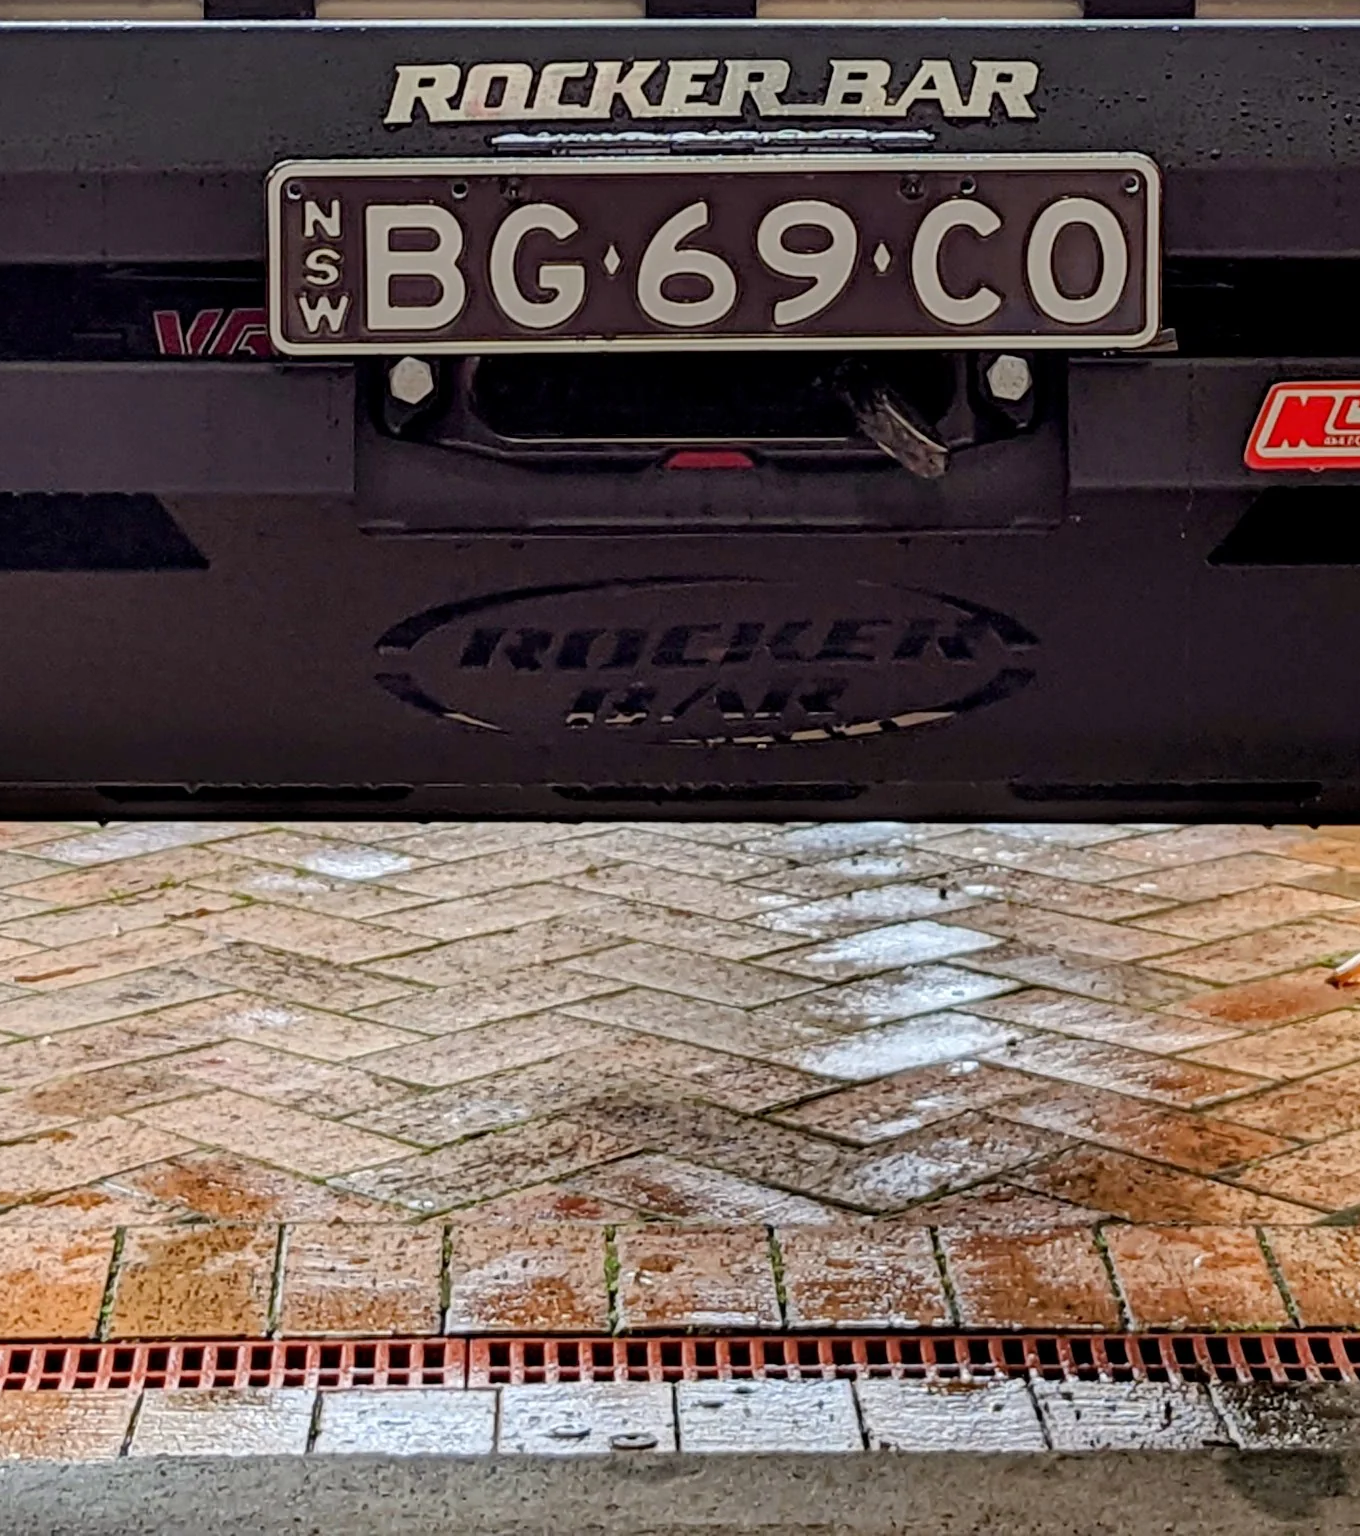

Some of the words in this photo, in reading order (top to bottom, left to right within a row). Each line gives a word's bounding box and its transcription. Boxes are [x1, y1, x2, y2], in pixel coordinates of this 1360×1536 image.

[383, 59, 790, 124] ROCKER
[825, 59, 1039, 120] BAR
[299, 199, 348, 333] NSW
[459, 617, 985, 672] ROCKER
